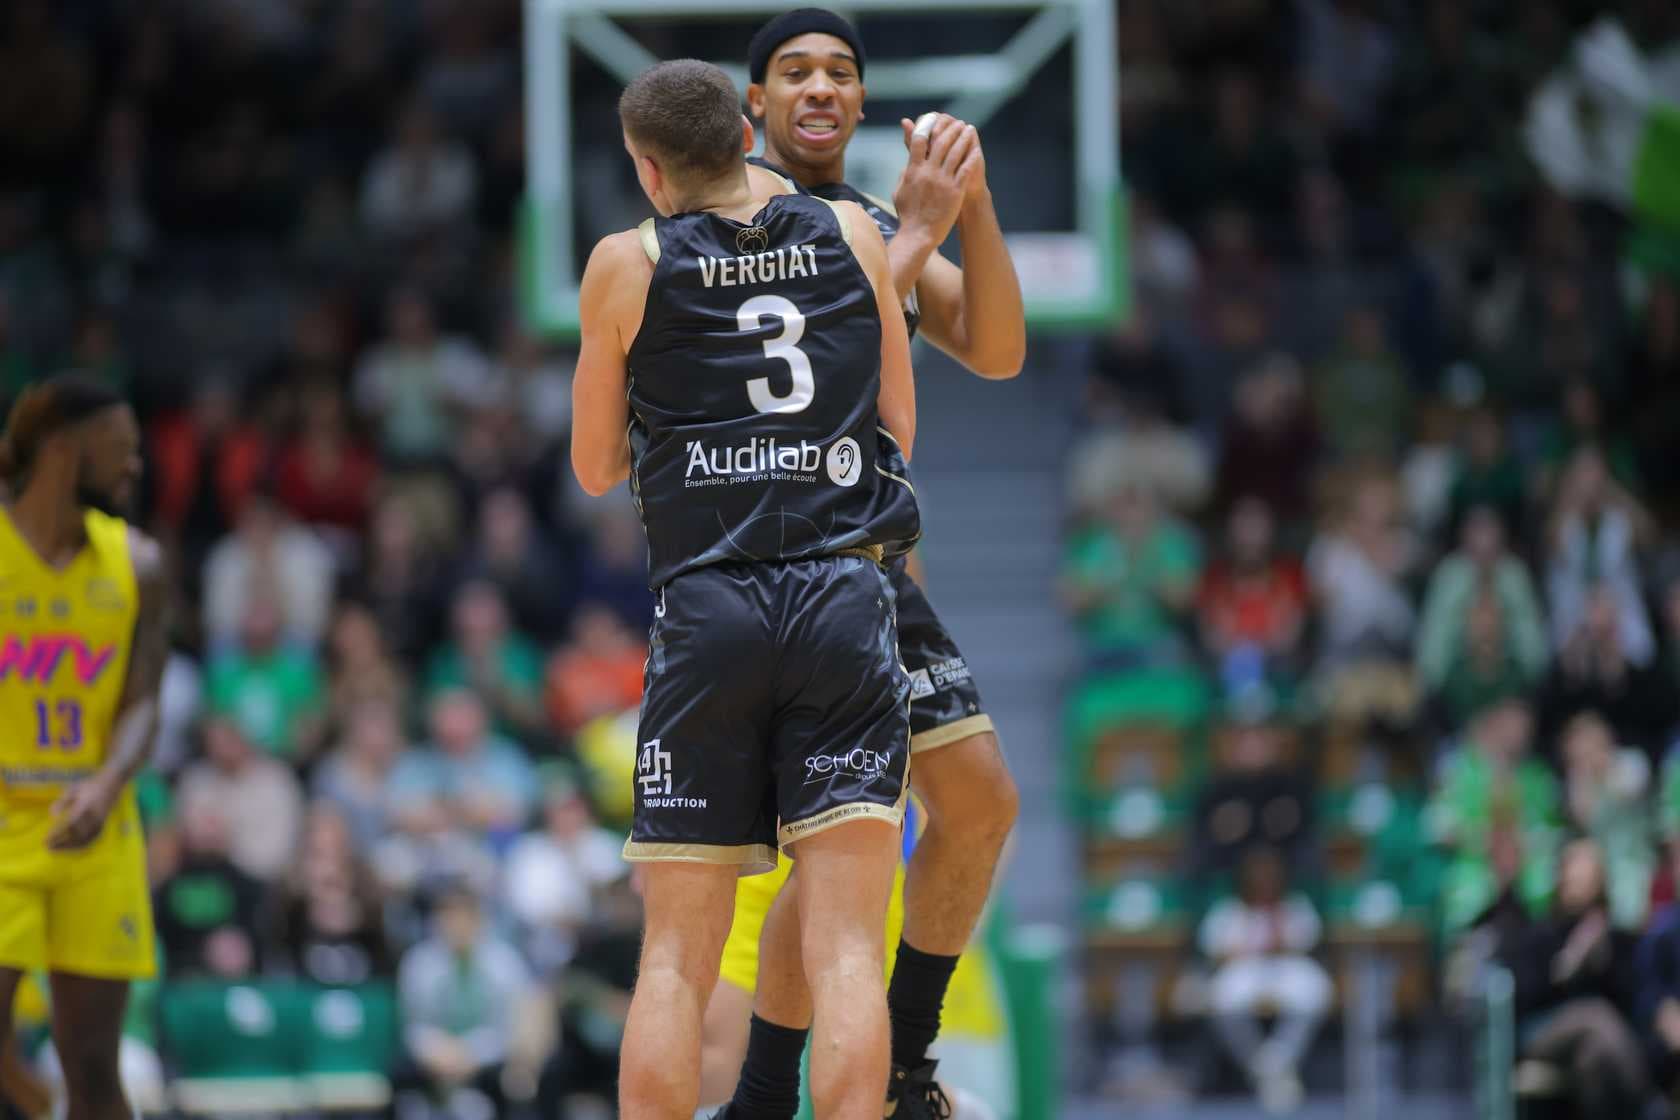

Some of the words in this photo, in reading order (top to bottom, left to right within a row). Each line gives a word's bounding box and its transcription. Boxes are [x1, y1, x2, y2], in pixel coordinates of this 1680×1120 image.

[698, 244, 819, 288] VERGIAT
[736, 294, 815, 414] 3
[685, 477, 728, 488] Ensemble,
[730, 475, 750, 485] pour
[752, 473, 769, 481] une
[771, 472, 791, 481] belle
[792, 472, 817, 483] écoute
[35, 697, 83, 751] 13
[805, 748, 890, 778] SCHOEN
